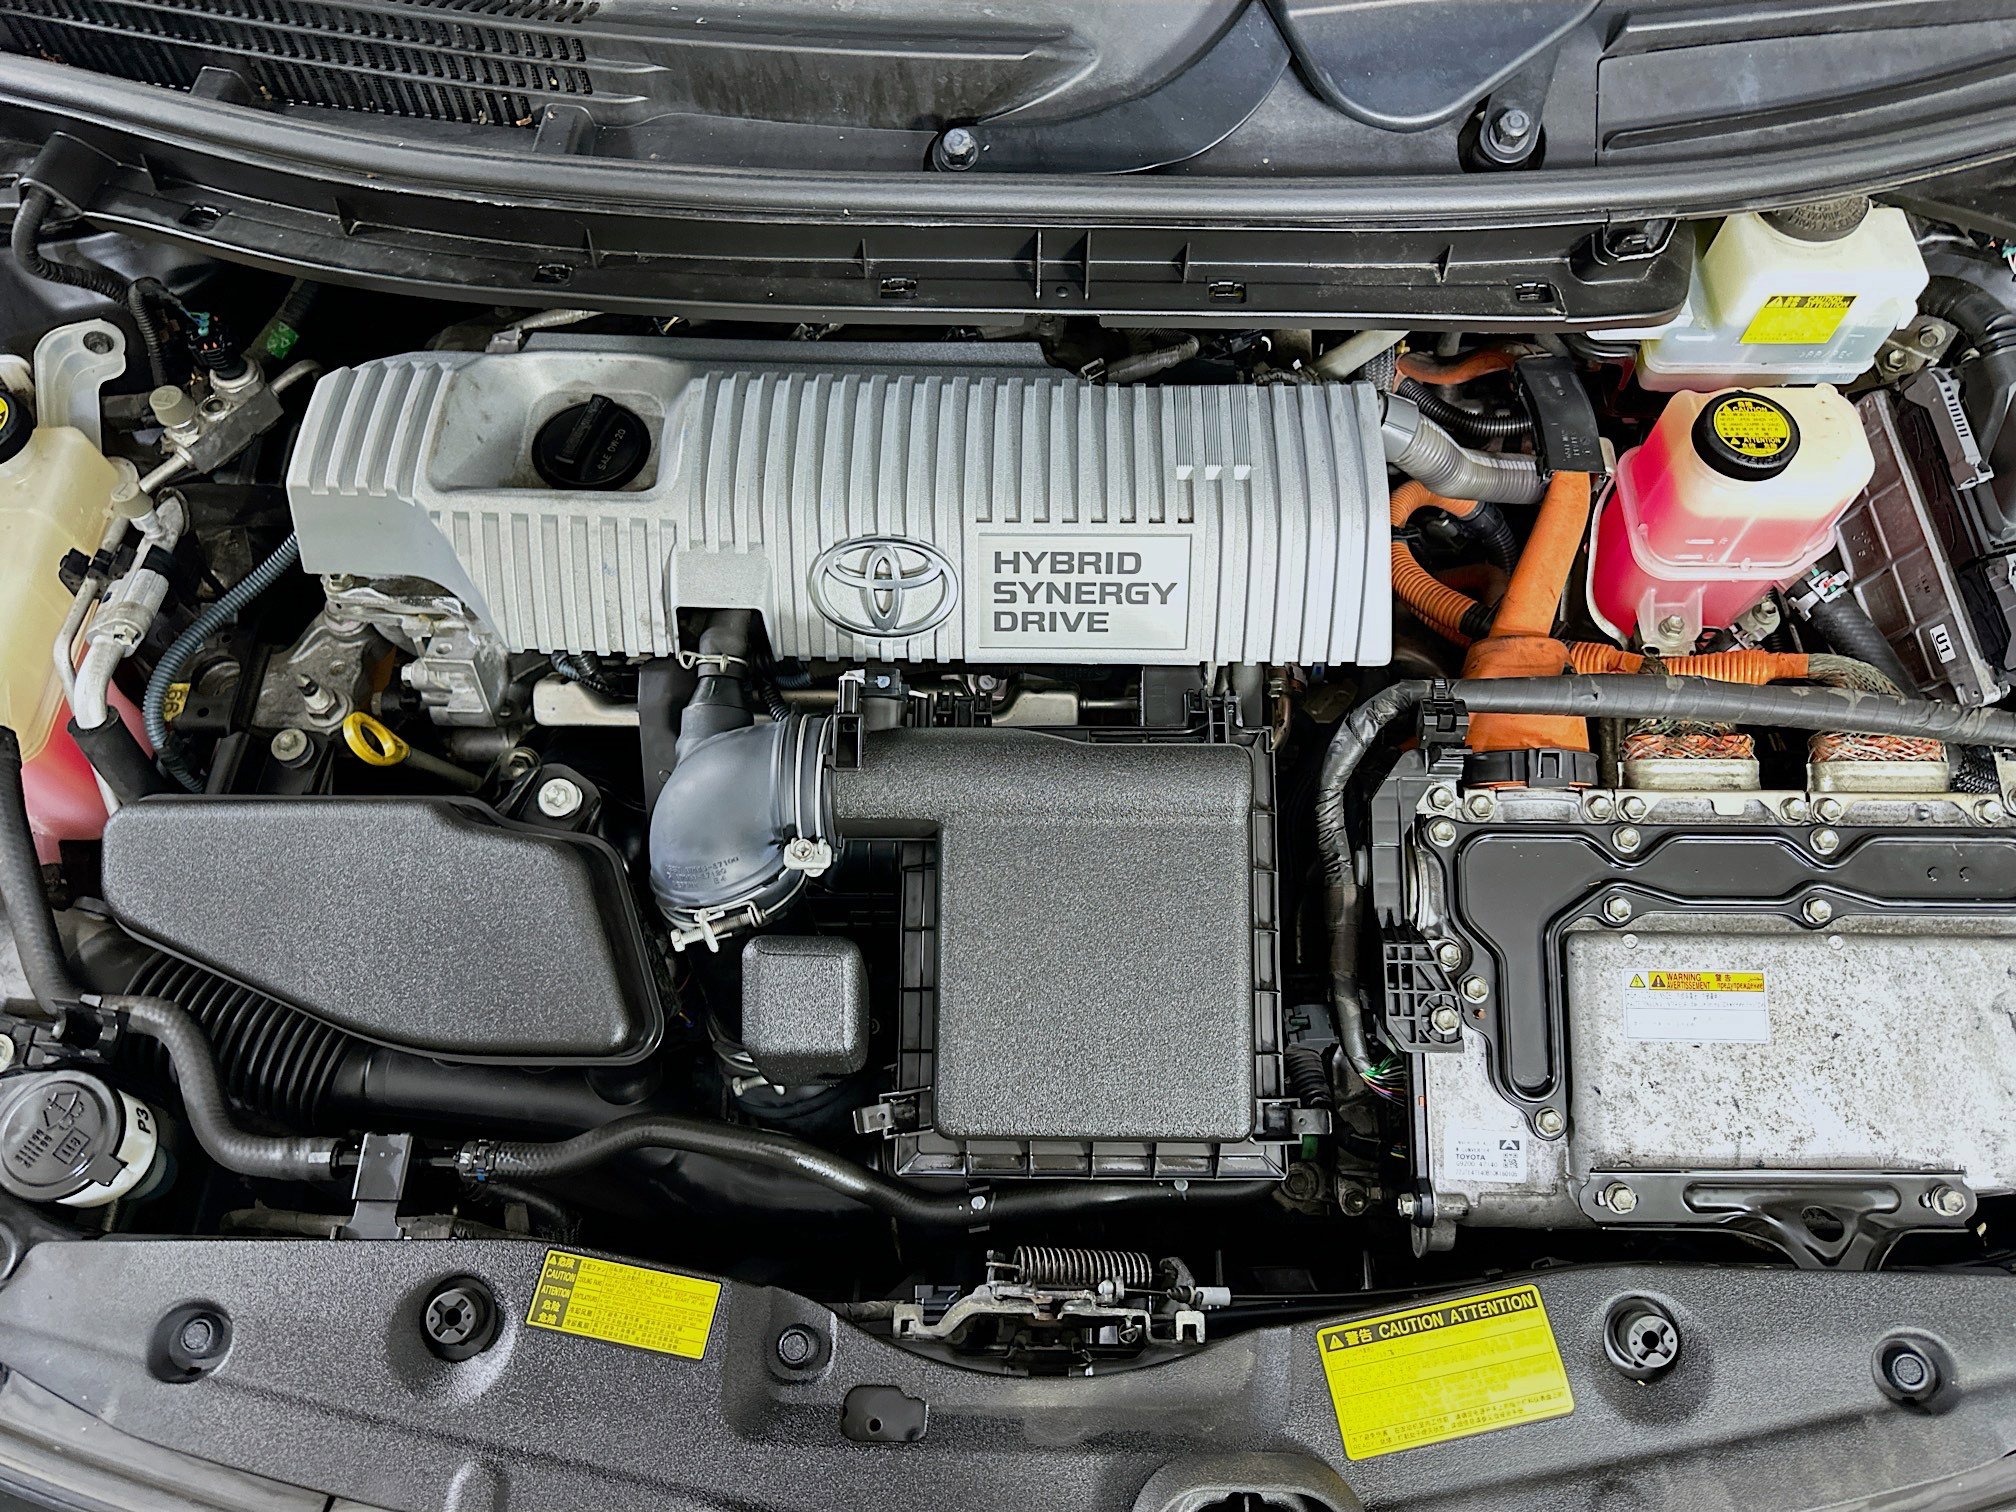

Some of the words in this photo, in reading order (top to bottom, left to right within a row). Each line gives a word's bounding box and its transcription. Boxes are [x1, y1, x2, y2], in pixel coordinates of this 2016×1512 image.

[597, 453, 612, 470] SAE
[993, 551, 1142, 575] HYBRID
[993, 582, 1178, 605] SYNERGY
[993, 611, 1110, 633] DRIVE
[1935, 632, 1951, 654] U1
[1666, 973, 1701, 982] WARNING
[1667, 982, 1710, 990] AVERTISSEMENT
[1717, 982, 1763, 991] предупреждение
[136, 1107, 151, 1135] P3
[545, 1268, 577, 1283] CAUTION
[540, 1284, 571, 1299] ATTENTION
[1378, 1312, 1445, 1339] CAUTION
[1450, 1292, 1535, 1324] ATTENTION
[1345, 1327, 1373, 1346] 警告
